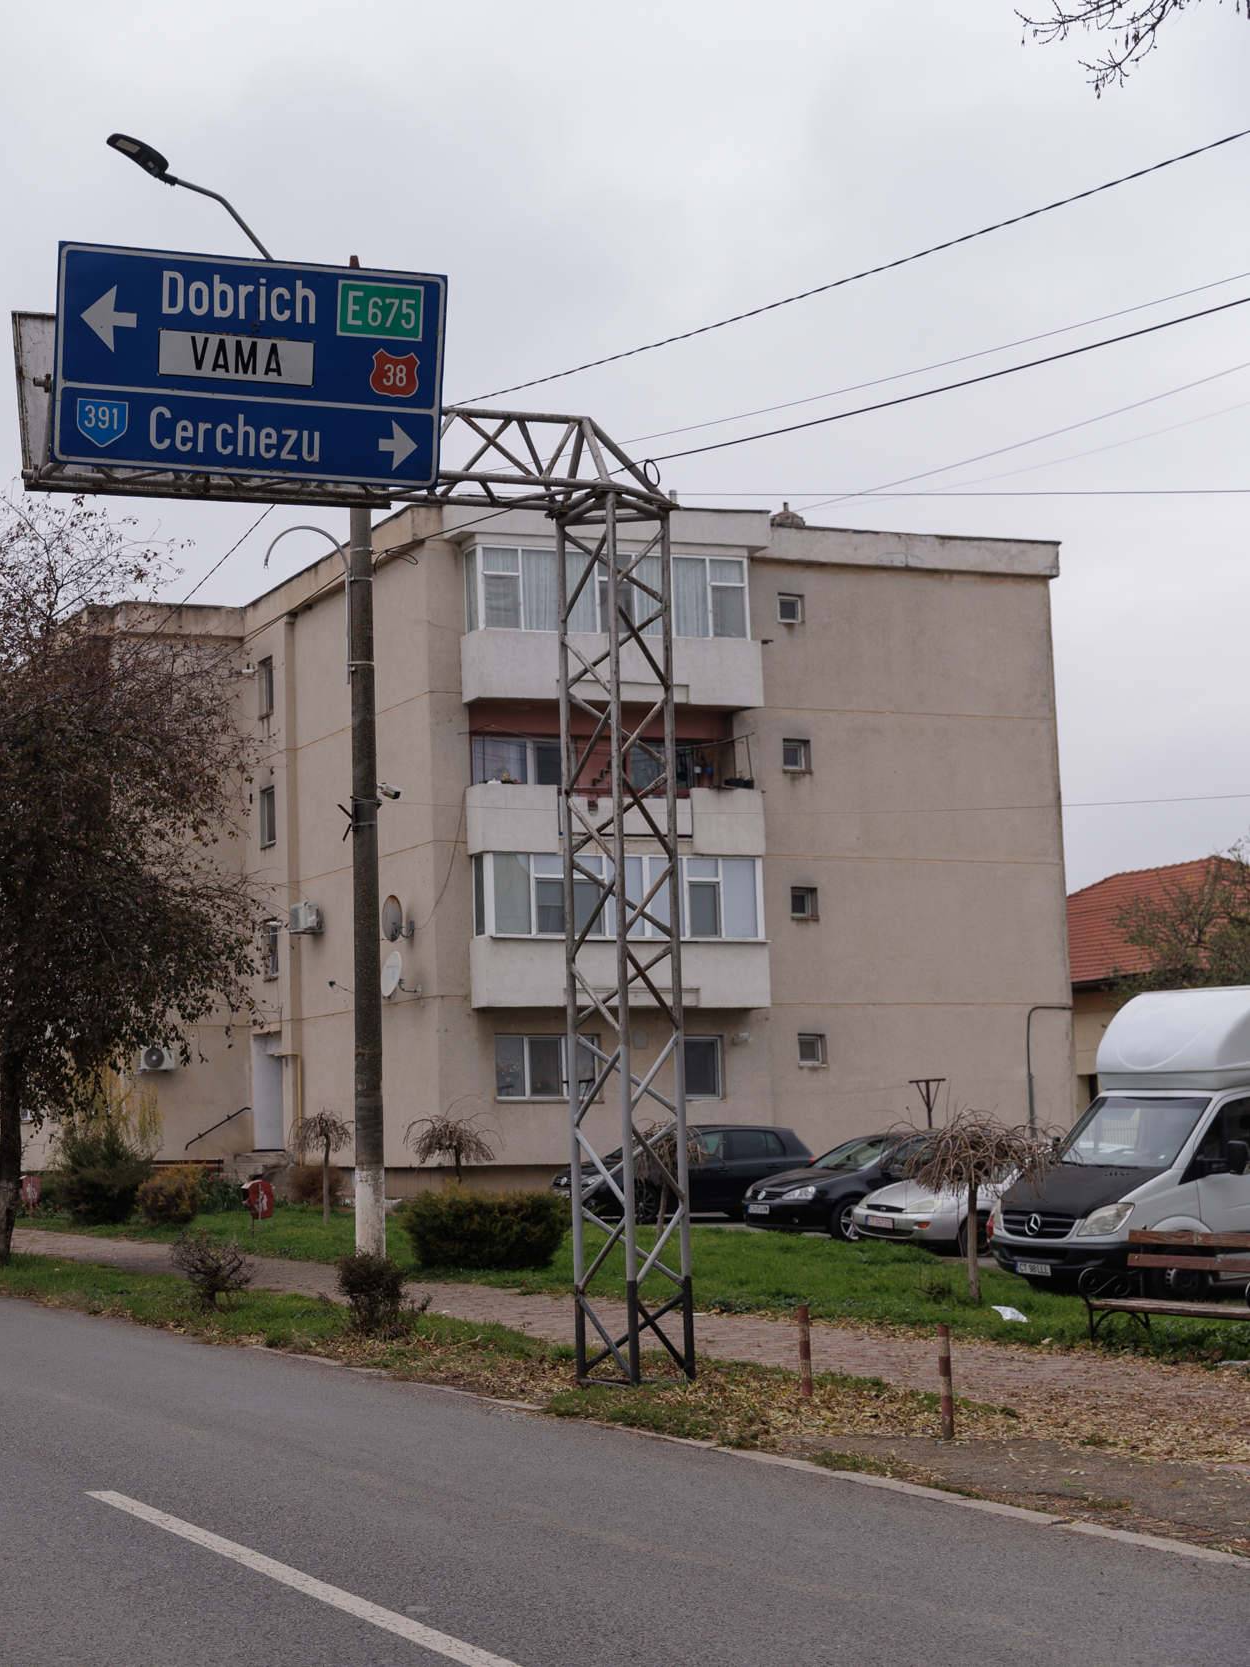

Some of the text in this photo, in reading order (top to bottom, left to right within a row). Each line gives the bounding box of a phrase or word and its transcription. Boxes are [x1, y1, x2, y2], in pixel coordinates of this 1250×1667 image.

[161, 270, 317, 325] Dobrich
[190, 335, 283, 378] VAMA
[382, 363, 408, 388] 38
[83, 405, 119, 430] 391
[149, 406, 321, 463] Cerchezu
[1019, 1263, 1027, 1272] CT
[1037, 1265, 1049, 1275] LLL
